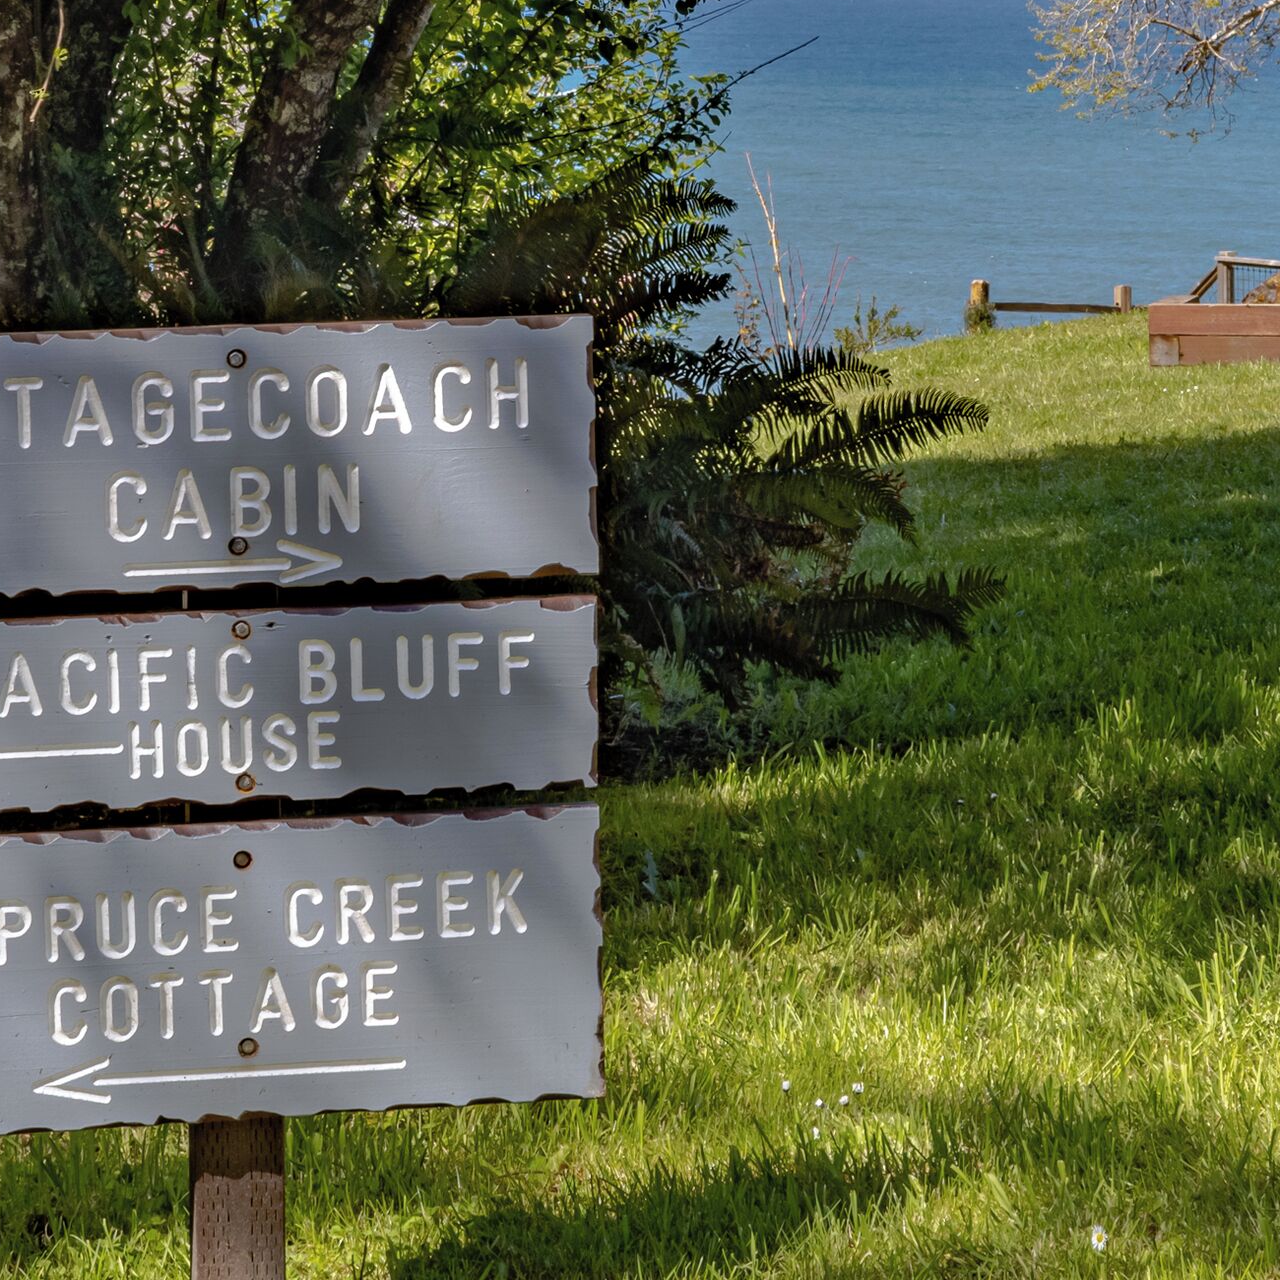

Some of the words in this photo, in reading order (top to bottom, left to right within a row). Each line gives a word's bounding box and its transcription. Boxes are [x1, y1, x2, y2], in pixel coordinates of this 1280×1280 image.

[108, 461, 362, 544] CABIN
[298, 631, 535, 706] BLUFF
[127, 710, 342, 780] HOUSE
[283, 869, 527, 949] CREEK
[49, 962, 400, 1047] COTTAGE
